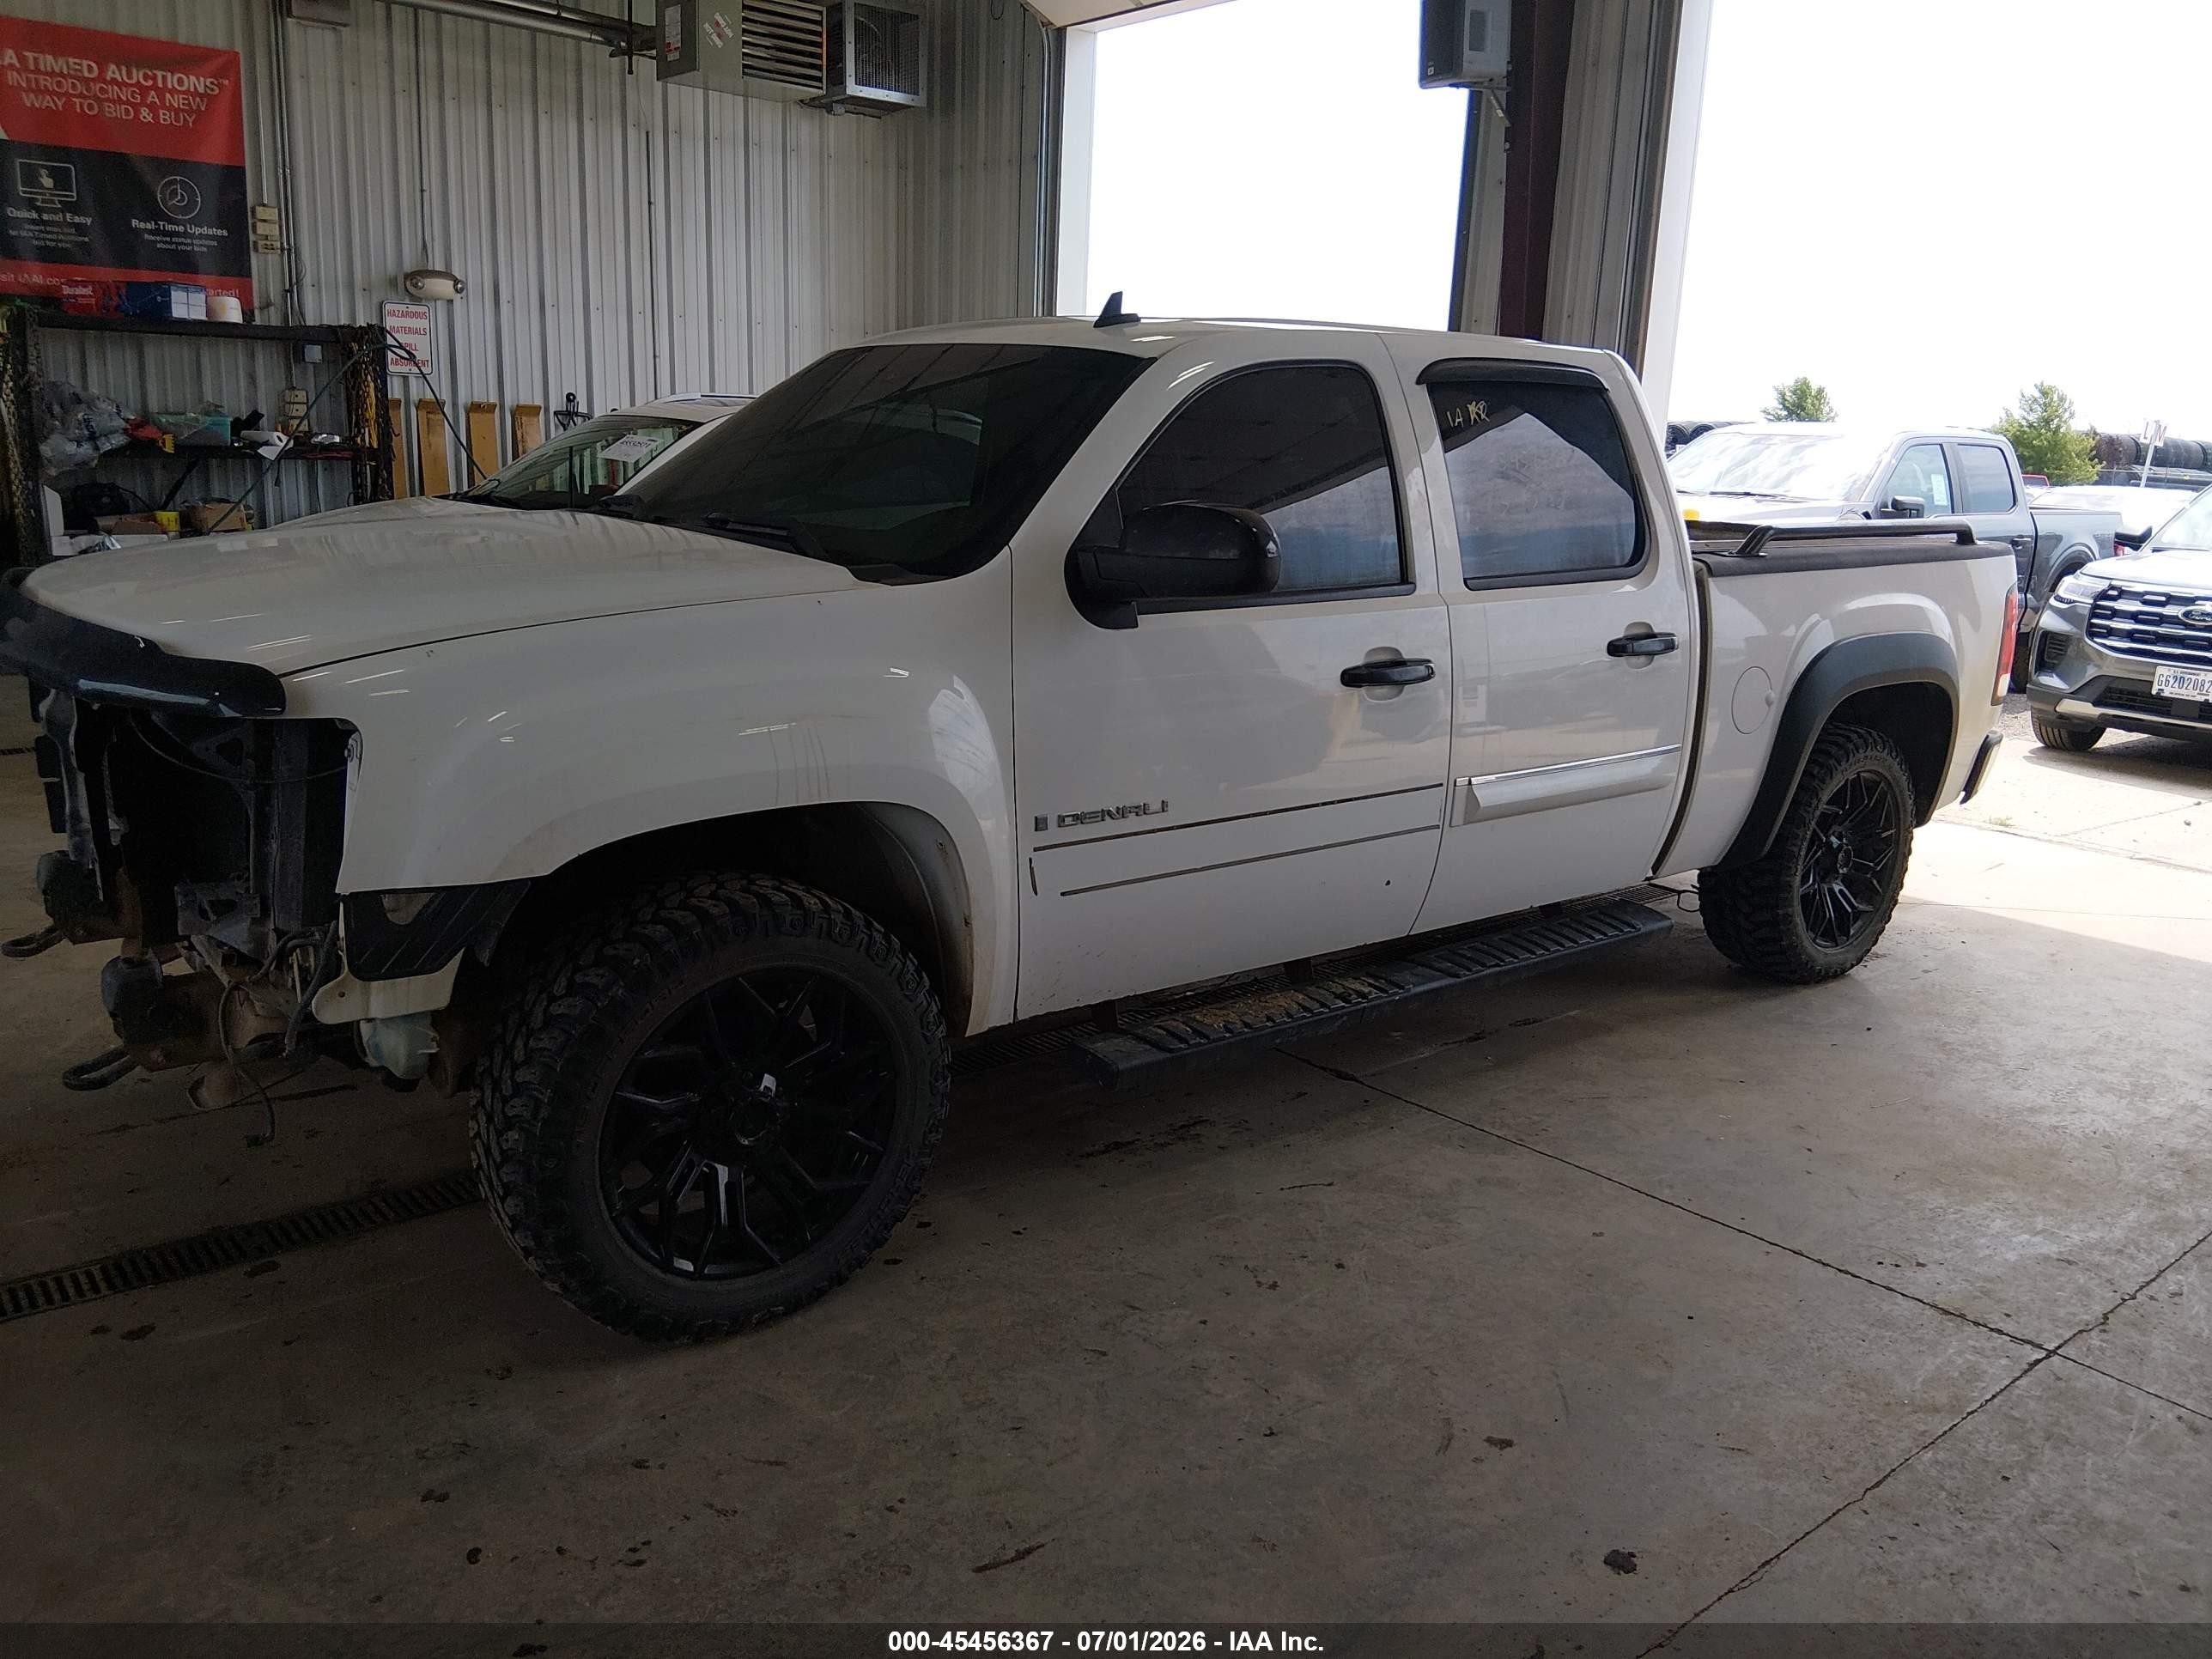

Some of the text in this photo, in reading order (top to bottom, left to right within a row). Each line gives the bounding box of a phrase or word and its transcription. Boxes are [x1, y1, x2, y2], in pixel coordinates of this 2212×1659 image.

[22, 52, 99, 78] TIMED
[7, 70, 207, 111] INTRODUCING A NEW
[21, 91, 196, 128] WAY TO BID & BUY
[7, 207, 92, 226] Quick and Easy
[131, 219, 228, 237] Real-Time Updates
[386, 309, 428, 320] HAZARDOUS
[389, 325, 428, 336] MATERIALS
[399, 342, 419, 352] PILL
[1057, 799, 1169, 828] DENALI
